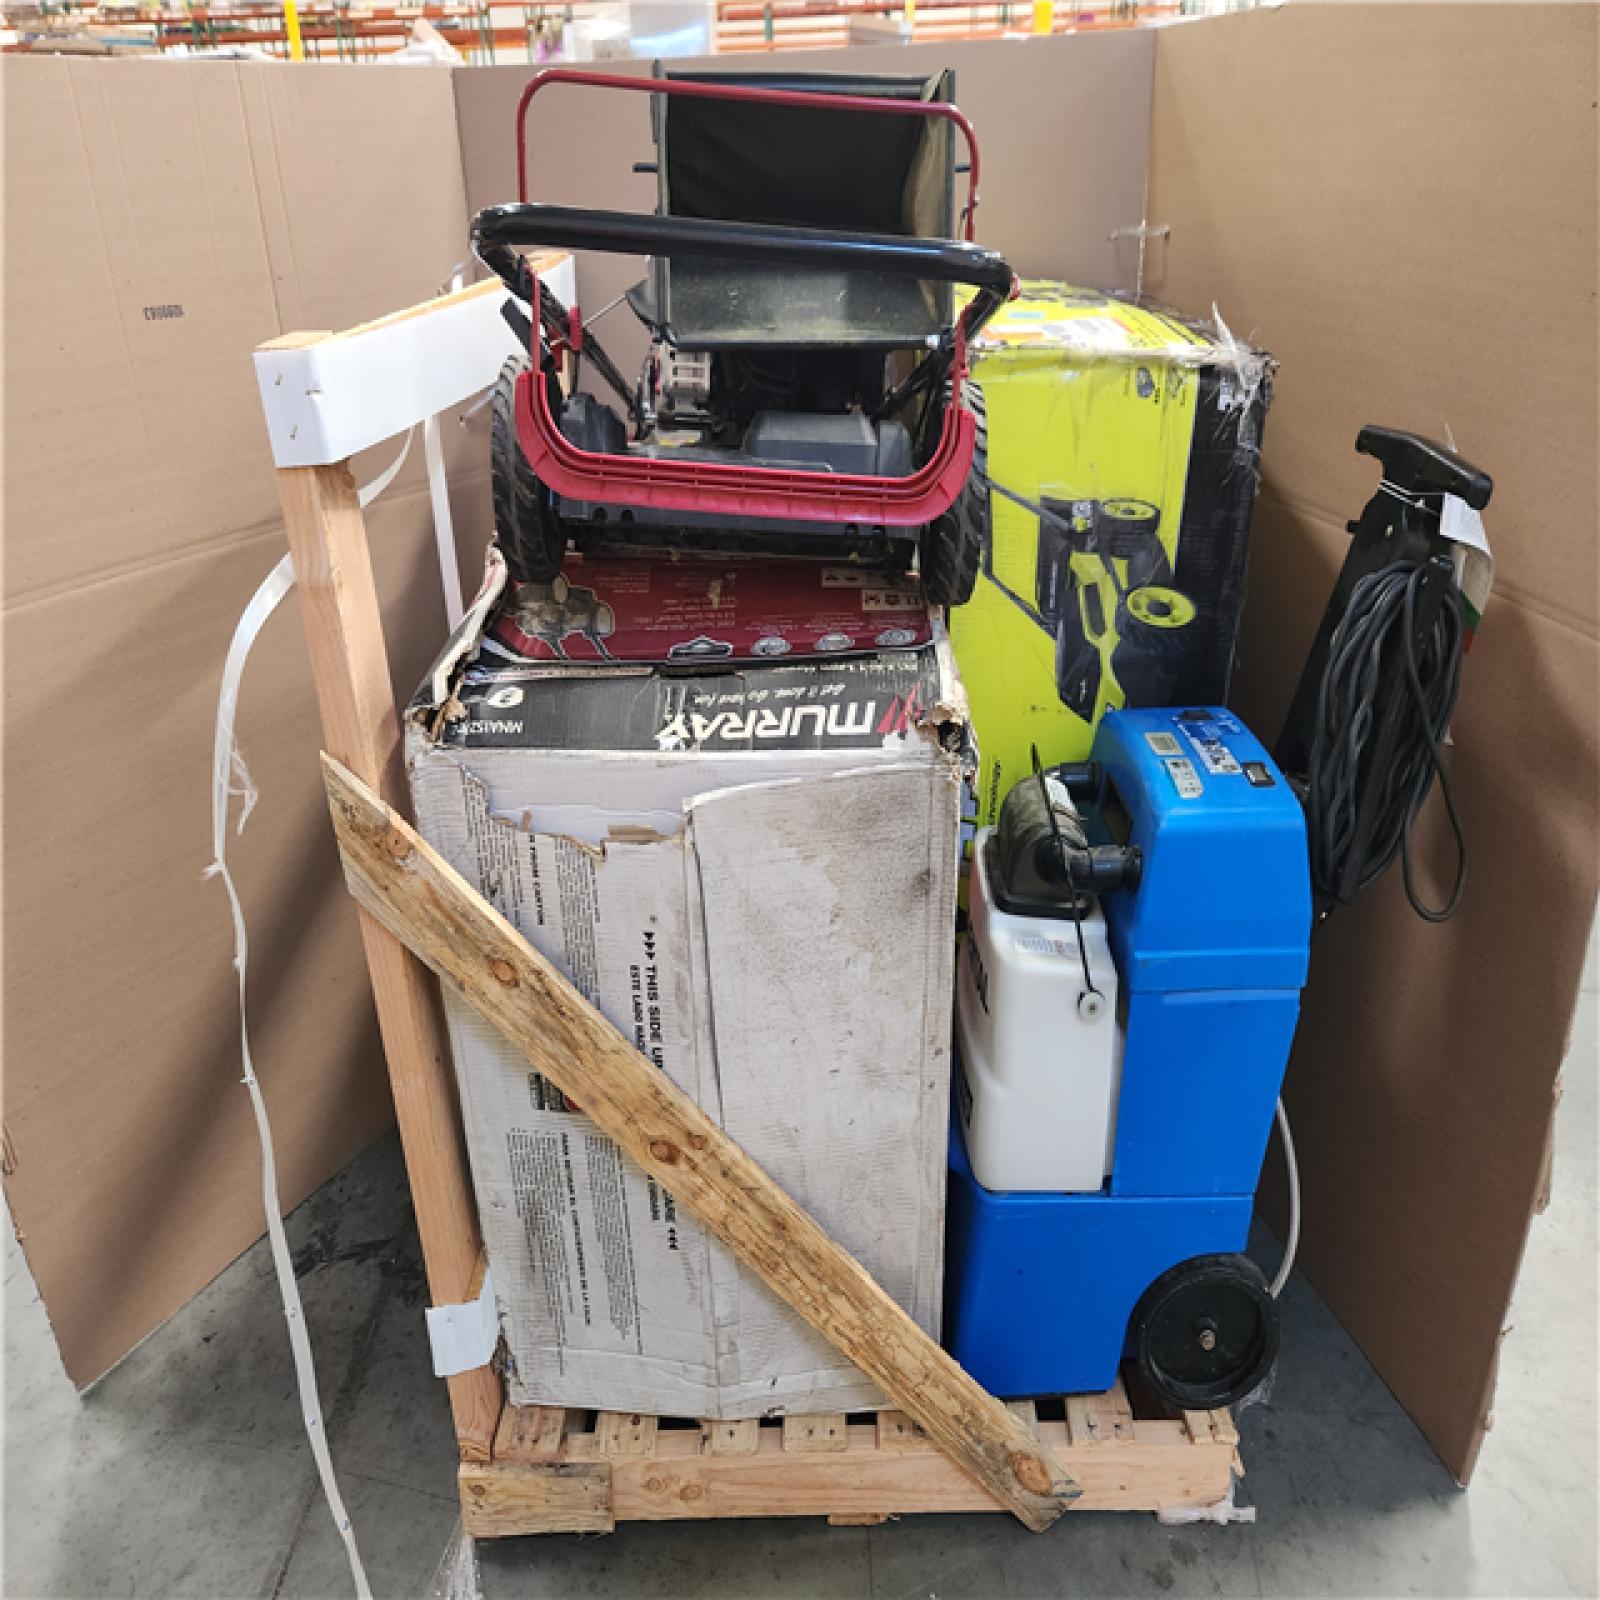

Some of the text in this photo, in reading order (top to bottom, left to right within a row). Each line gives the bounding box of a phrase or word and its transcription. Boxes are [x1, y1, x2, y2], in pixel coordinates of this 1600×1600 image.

[654, 700, 877, 742] MURRAY
[629, 964, 642, 992] ESTE
[644, 964, 661, 1001] THIS
[647, 1004, 664, 1044] SIDE
